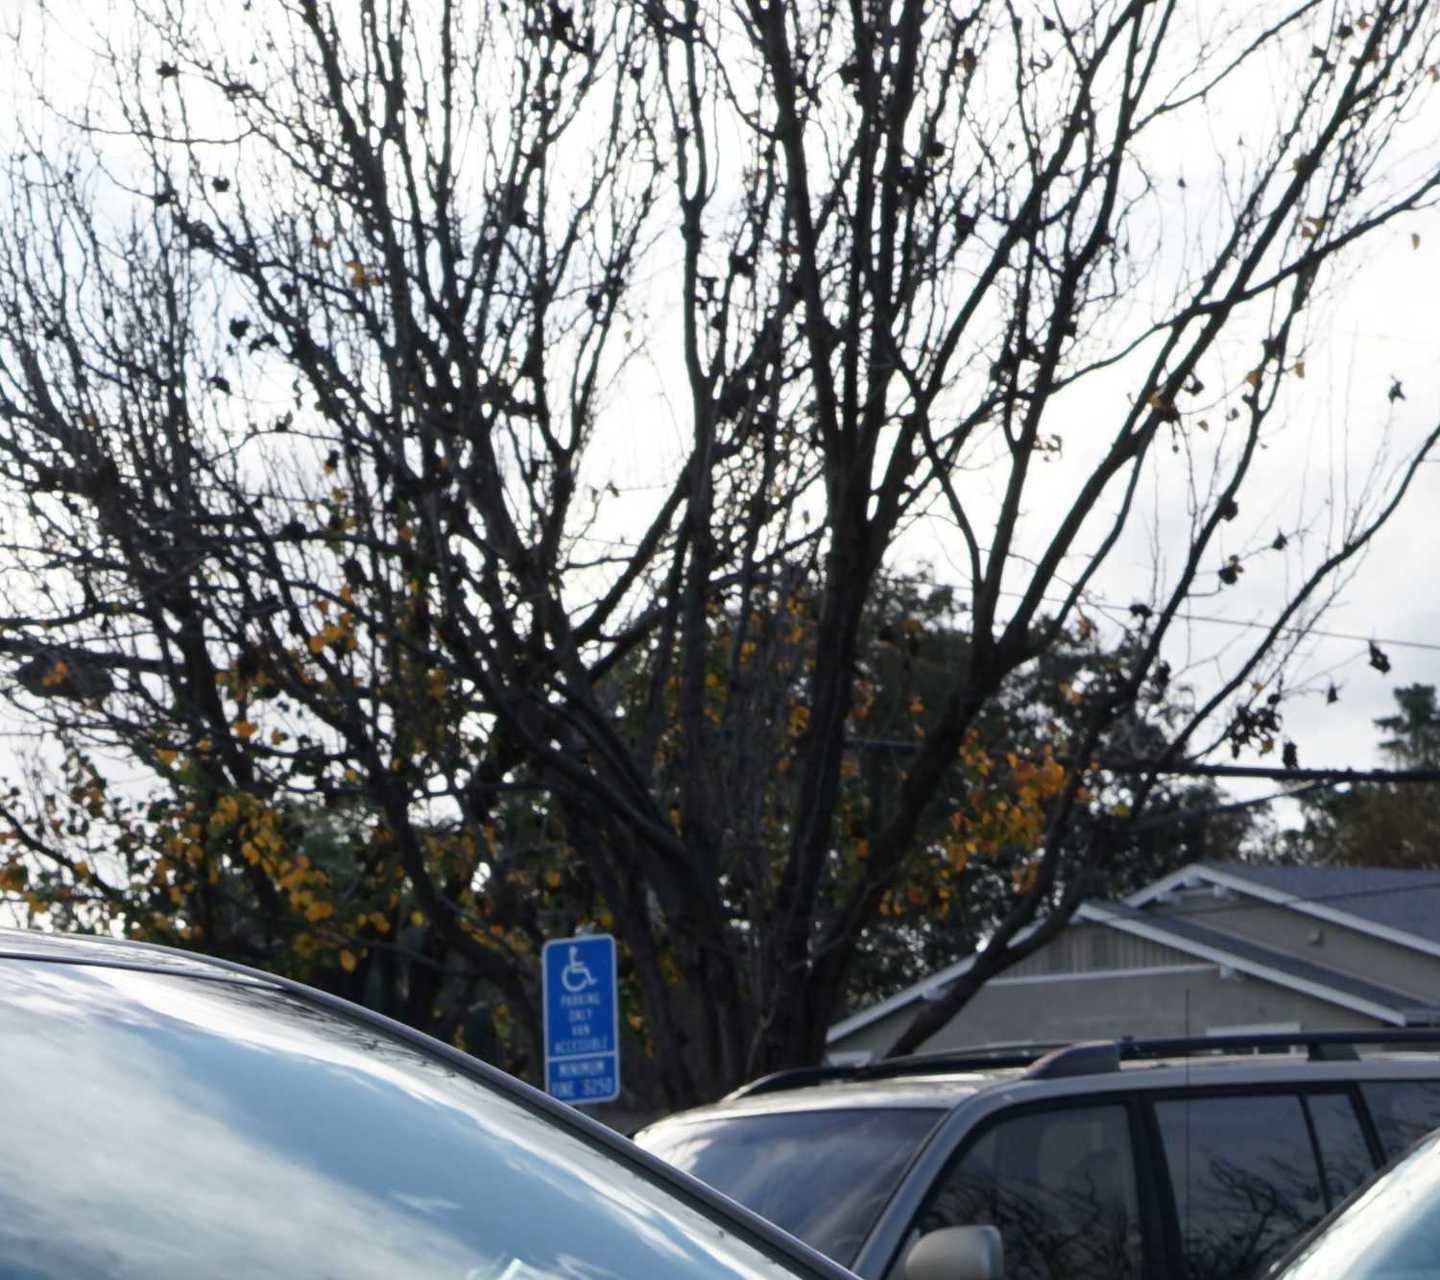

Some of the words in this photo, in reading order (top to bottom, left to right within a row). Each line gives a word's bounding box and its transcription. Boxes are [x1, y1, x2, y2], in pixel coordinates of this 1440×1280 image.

[560, 992, 600, 1008] PARKING
[568, 1008, 593, 1023] ONLY
[558, 1060, 606, 1079] MINIMUM
